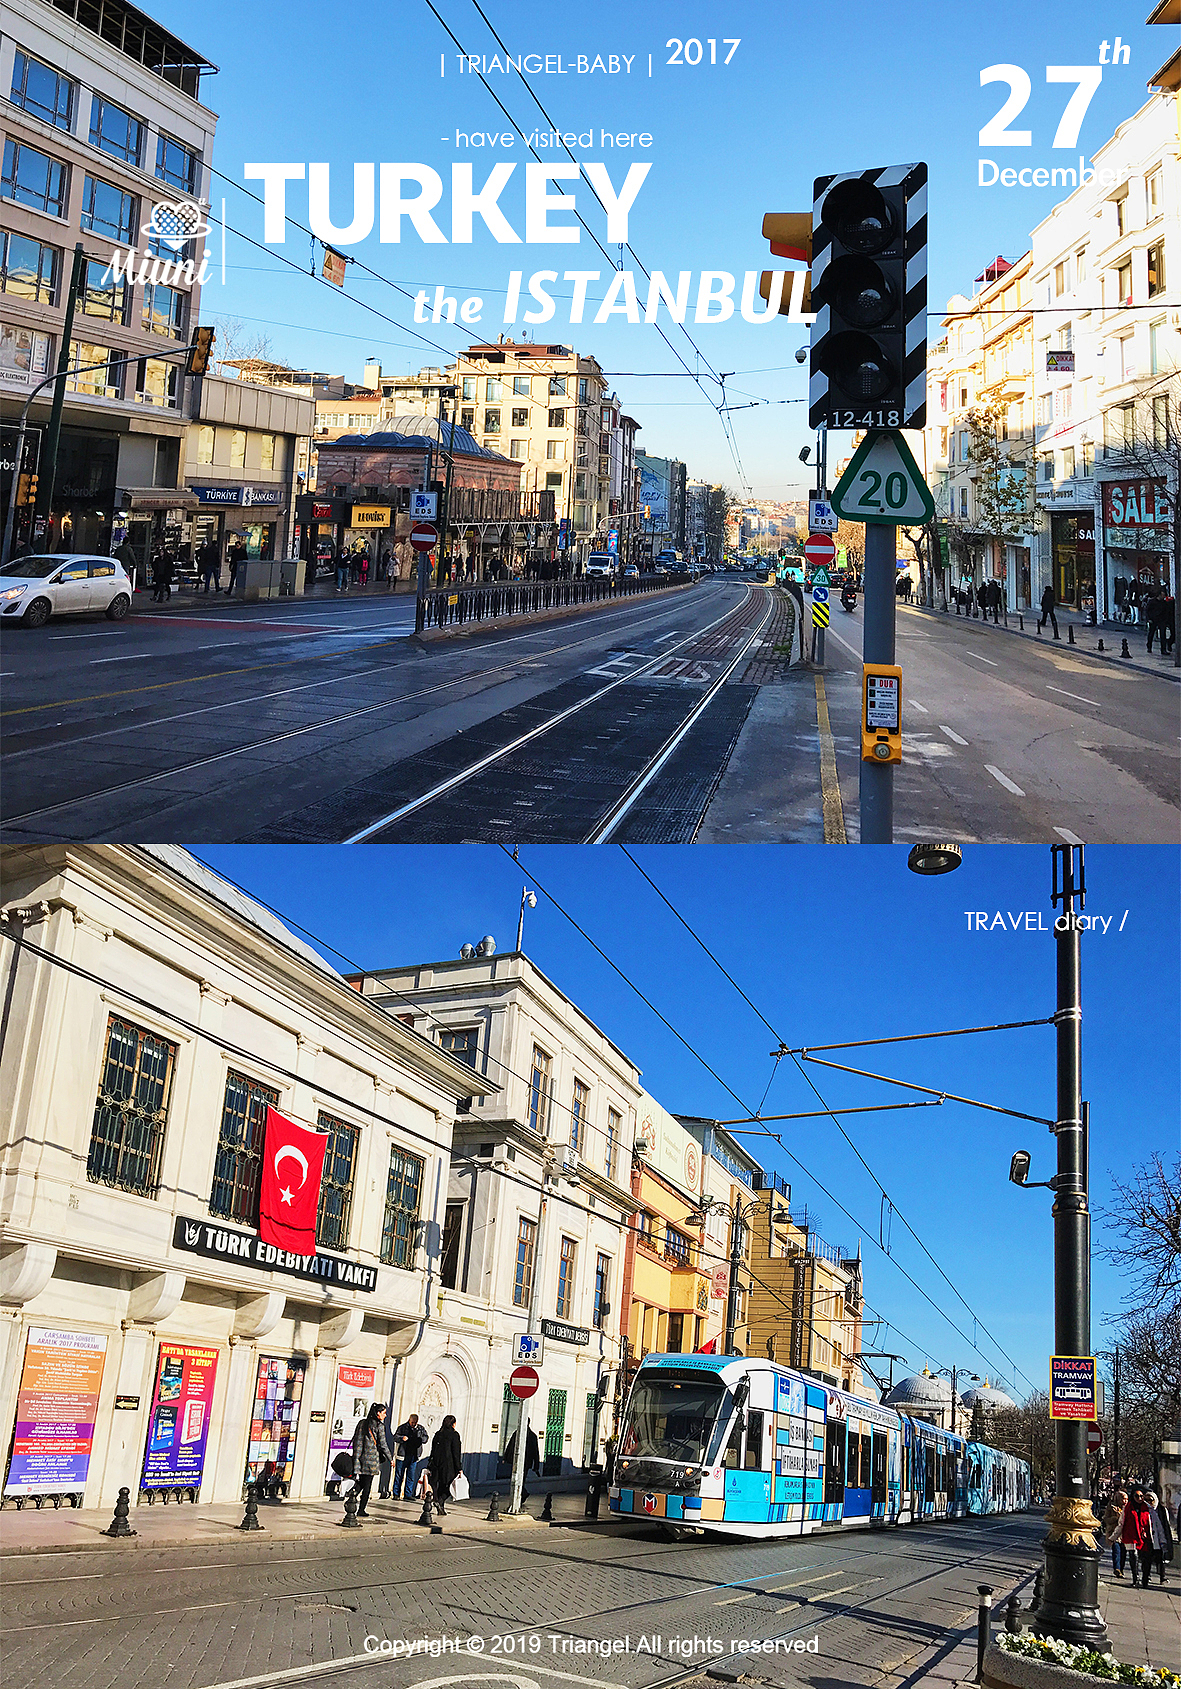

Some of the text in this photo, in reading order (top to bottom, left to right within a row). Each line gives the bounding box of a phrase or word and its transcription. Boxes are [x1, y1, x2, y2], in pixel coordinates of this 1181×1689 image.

[832, 411, 900, 428] 12-418
[206, 488, 238, 500] TÜRKİYE
[857, 470, 910, 509] 20
[1111, 484, 1170, 524] SALE
[814, 518, 833, 526] EDS
[816, 574, 826, 583] 30
[1139, 573, 1155, 586] SALE
[880, 679, 893, 688] DUR
[205, 1227, 252, 1258] TÜRK
[337, 1262, 375, 1288] VAKFI
[1053, 1360, 1093, 1370] DİKKAT
[1053, 1372, 1093, 1380] TRAMVAY
[670, 1469, 684, 1479] 719
